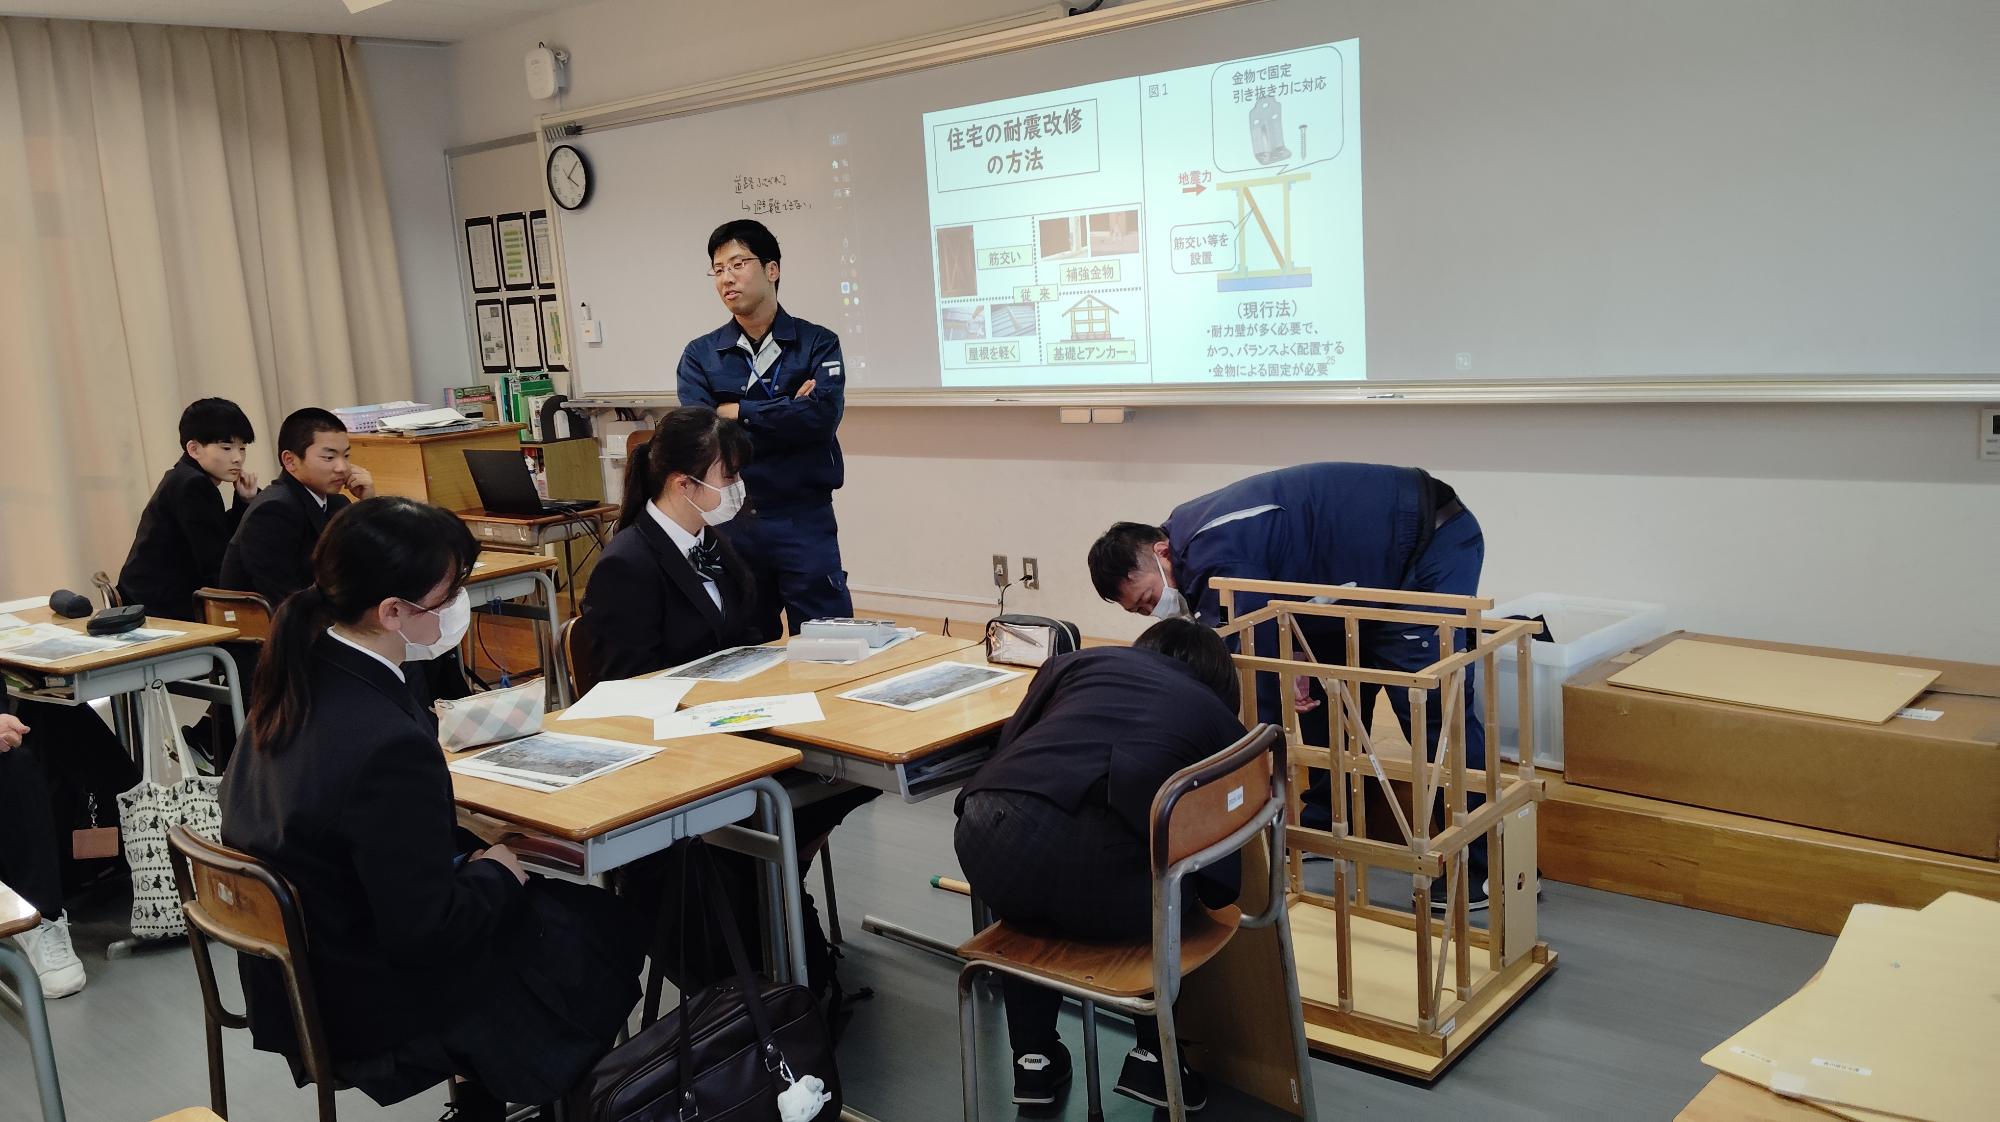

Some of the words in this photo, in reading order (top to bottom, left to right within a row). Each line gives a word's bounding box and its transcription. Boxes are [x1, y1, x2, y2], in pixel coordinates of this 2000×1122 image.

[1231, 62, 1292, 86] 金物で固定
[1232, 75, 1327, 104] 引き抜き力に対応
[947, 107, 1083, 152] 住宅の耐震改修
[986, 146, 1045, 175] の方法
[1178, 169, 1212, 186] 地震力
[1173, 232, 1229, 250] 筋交い等を
[988, 250, 1021, 267] 筋交い
[1190, 251, 1213, 266] 設置
[1066, 264, 1114, 282] 補強金物
[968, 343, 1016, 361] 屋根を軽く
[1054, 344, 1129, 361] 基礎とアンカー
[1206, 341, 1345, 358] かつ、バランスよく配置する
